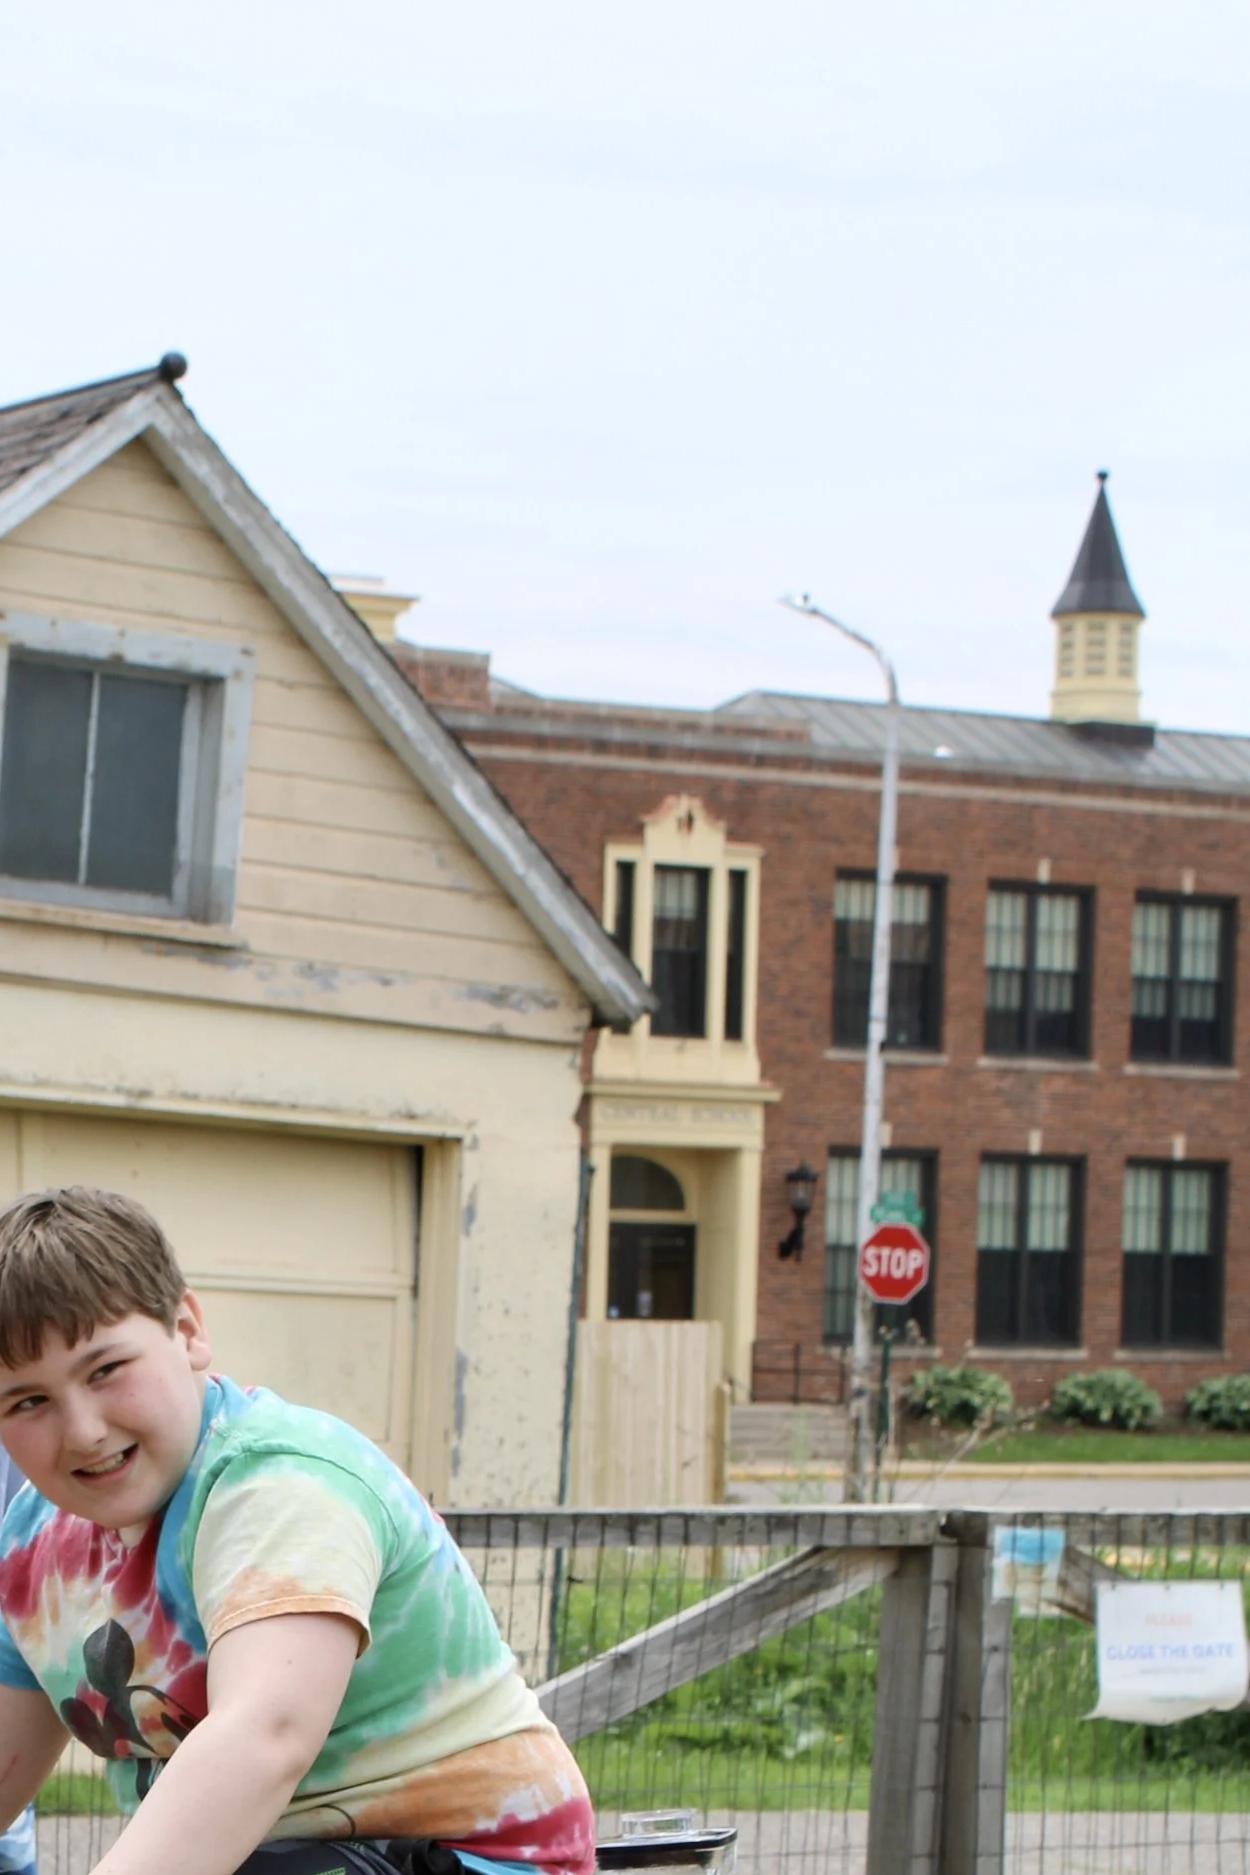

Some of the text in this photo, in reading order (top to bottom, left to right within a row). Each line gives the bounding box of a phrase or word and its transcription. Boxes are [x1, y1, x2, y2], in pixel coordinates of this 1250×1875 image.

[862, 1245, 924, 1280] STOP
[1106, 1641, 1235, 1660] CLOSE THE GATE
